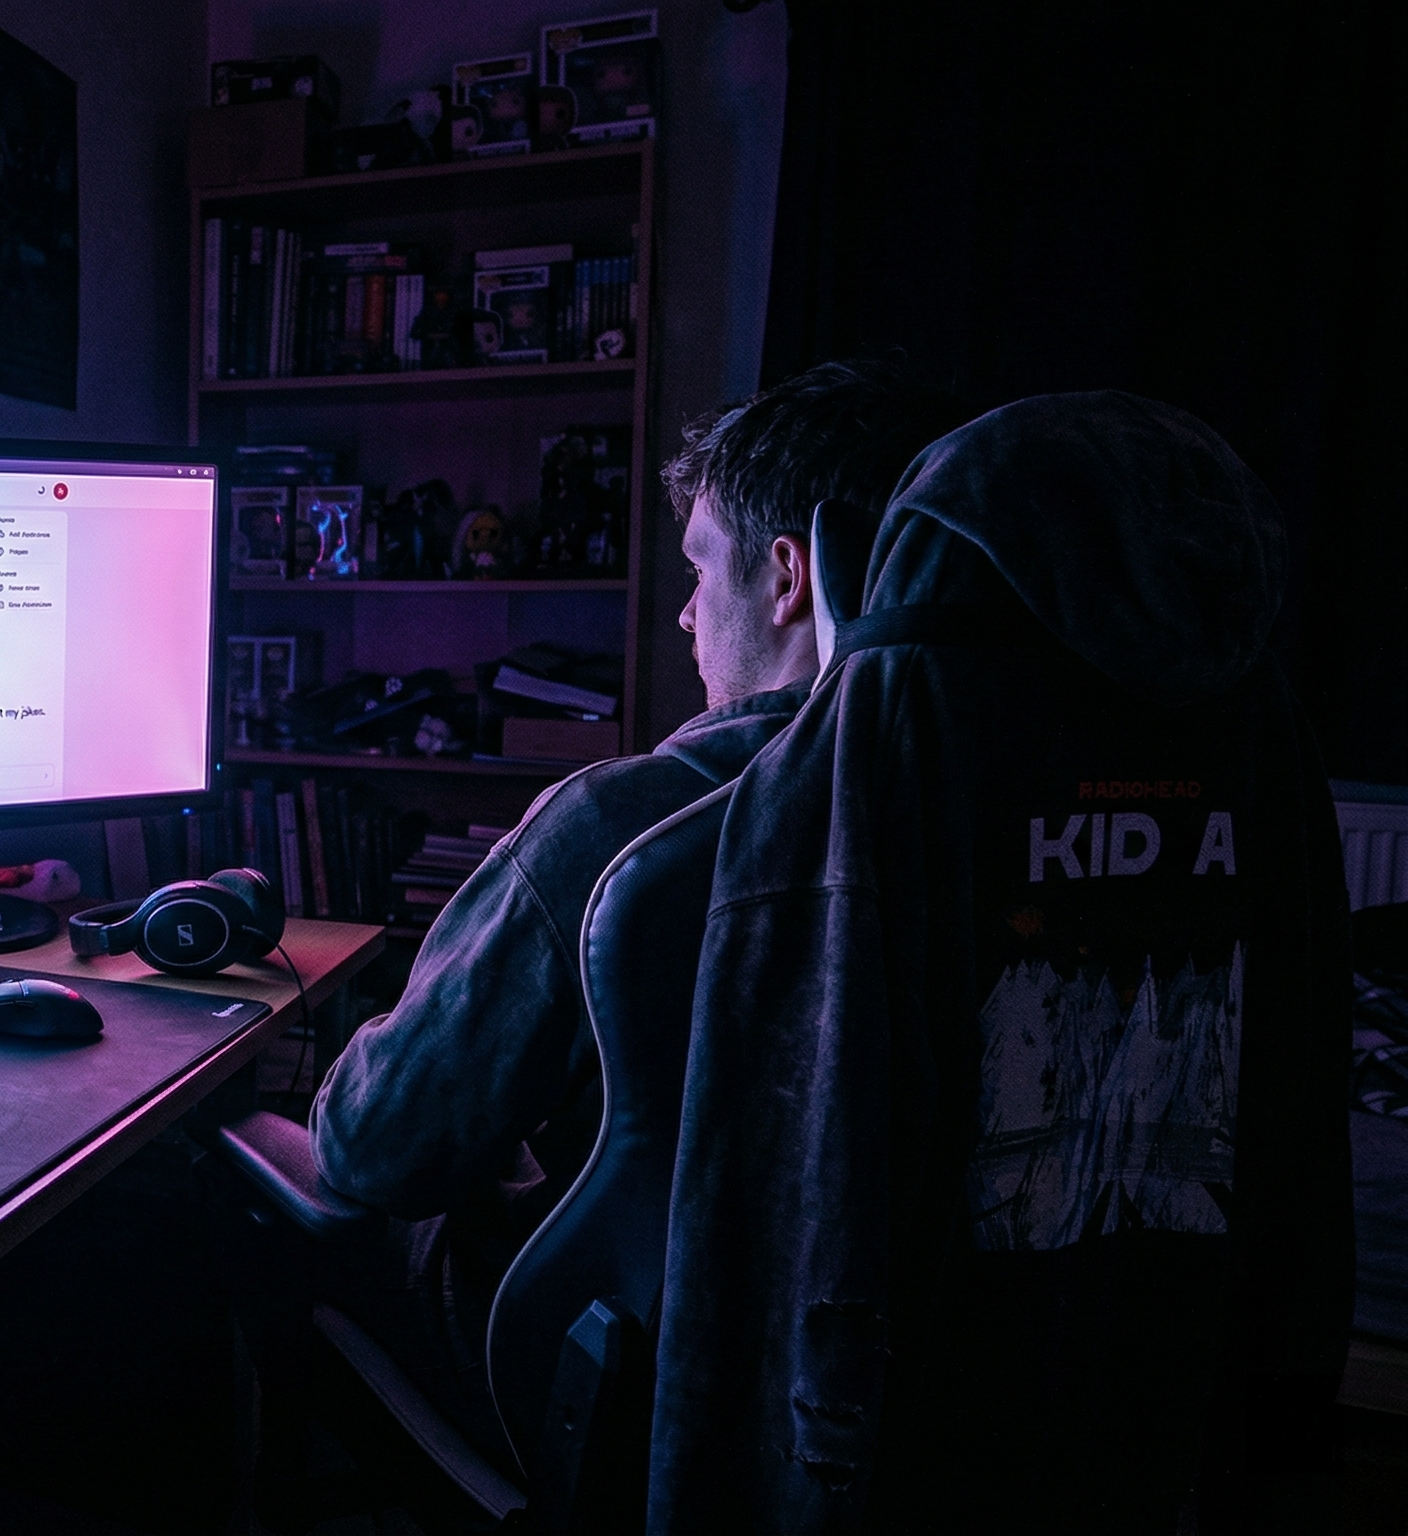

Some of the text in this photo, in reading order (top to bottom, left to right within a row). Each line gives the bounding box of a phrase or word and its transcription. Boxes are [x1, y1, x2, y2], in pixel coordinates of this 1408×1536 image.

[1077, 779, 1202, 800] RADIOHEAD
[1029, 811, 1237, 883] KID A
